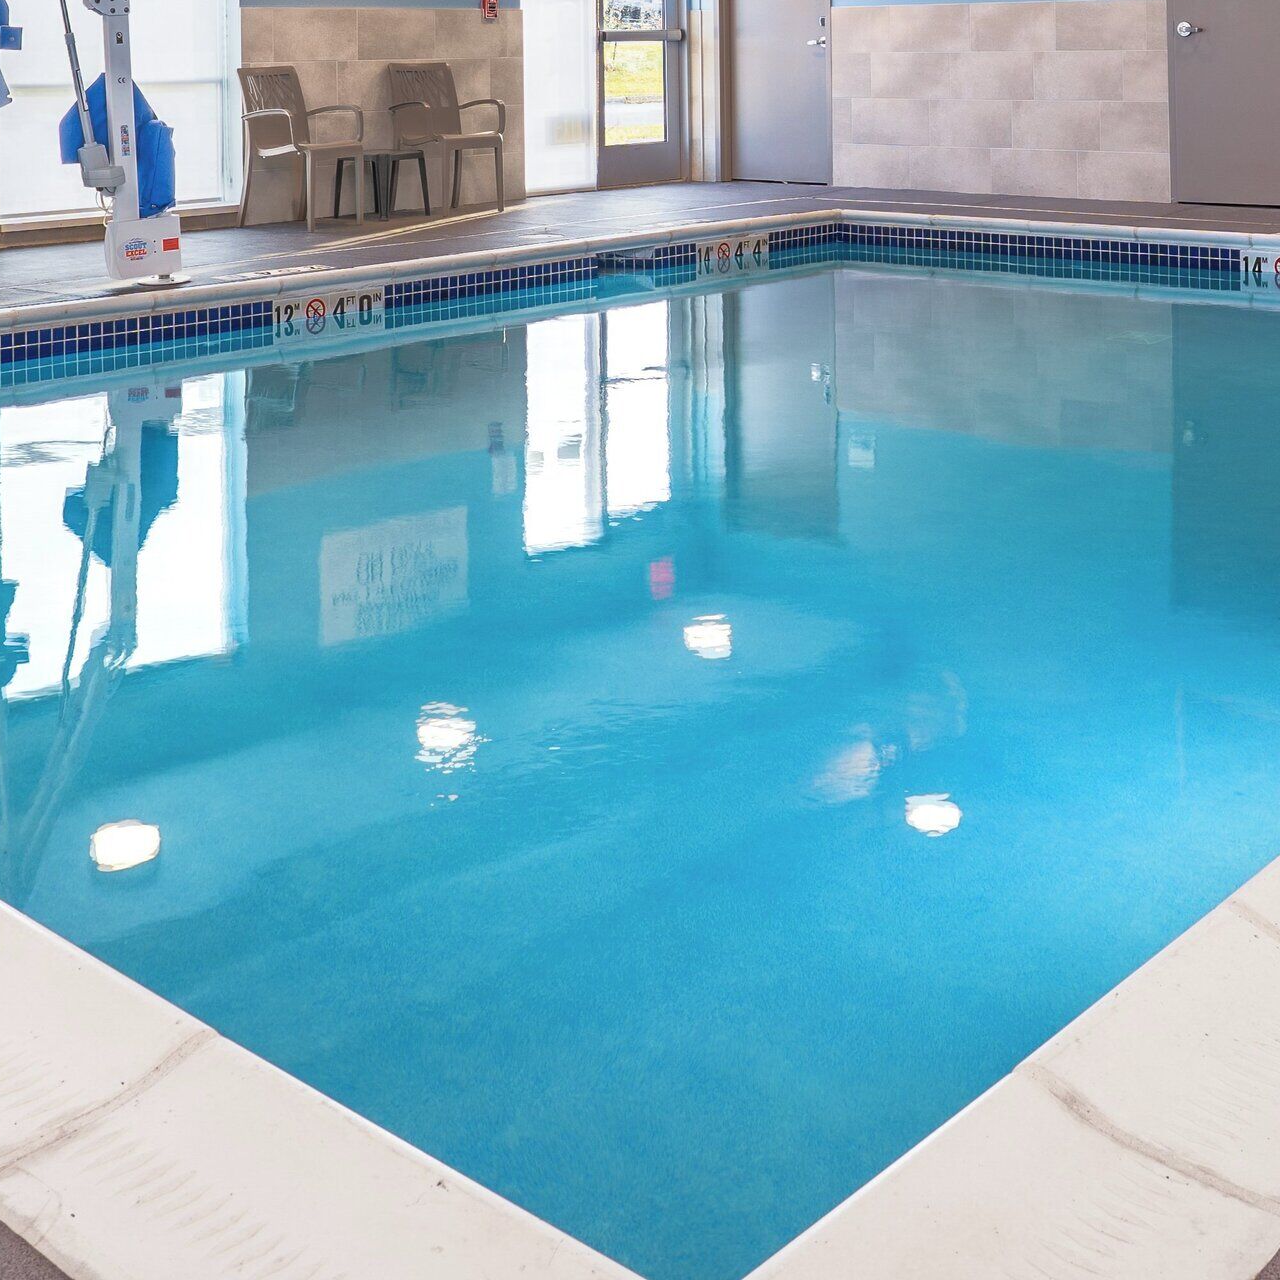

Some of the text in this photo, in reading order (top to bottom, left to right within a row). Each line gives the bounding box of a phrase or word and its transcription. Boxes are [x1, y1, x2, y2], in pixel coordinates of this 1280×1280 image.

[125, 242, 147, 250] SCOUT
[744, 241, 750, 249] FT
[762, 238, 768, 246] IN
[125, 249, 147, 257] EXCEL
[346, 295, 356, 306] FT
[373, 292, 382, 303] IN
